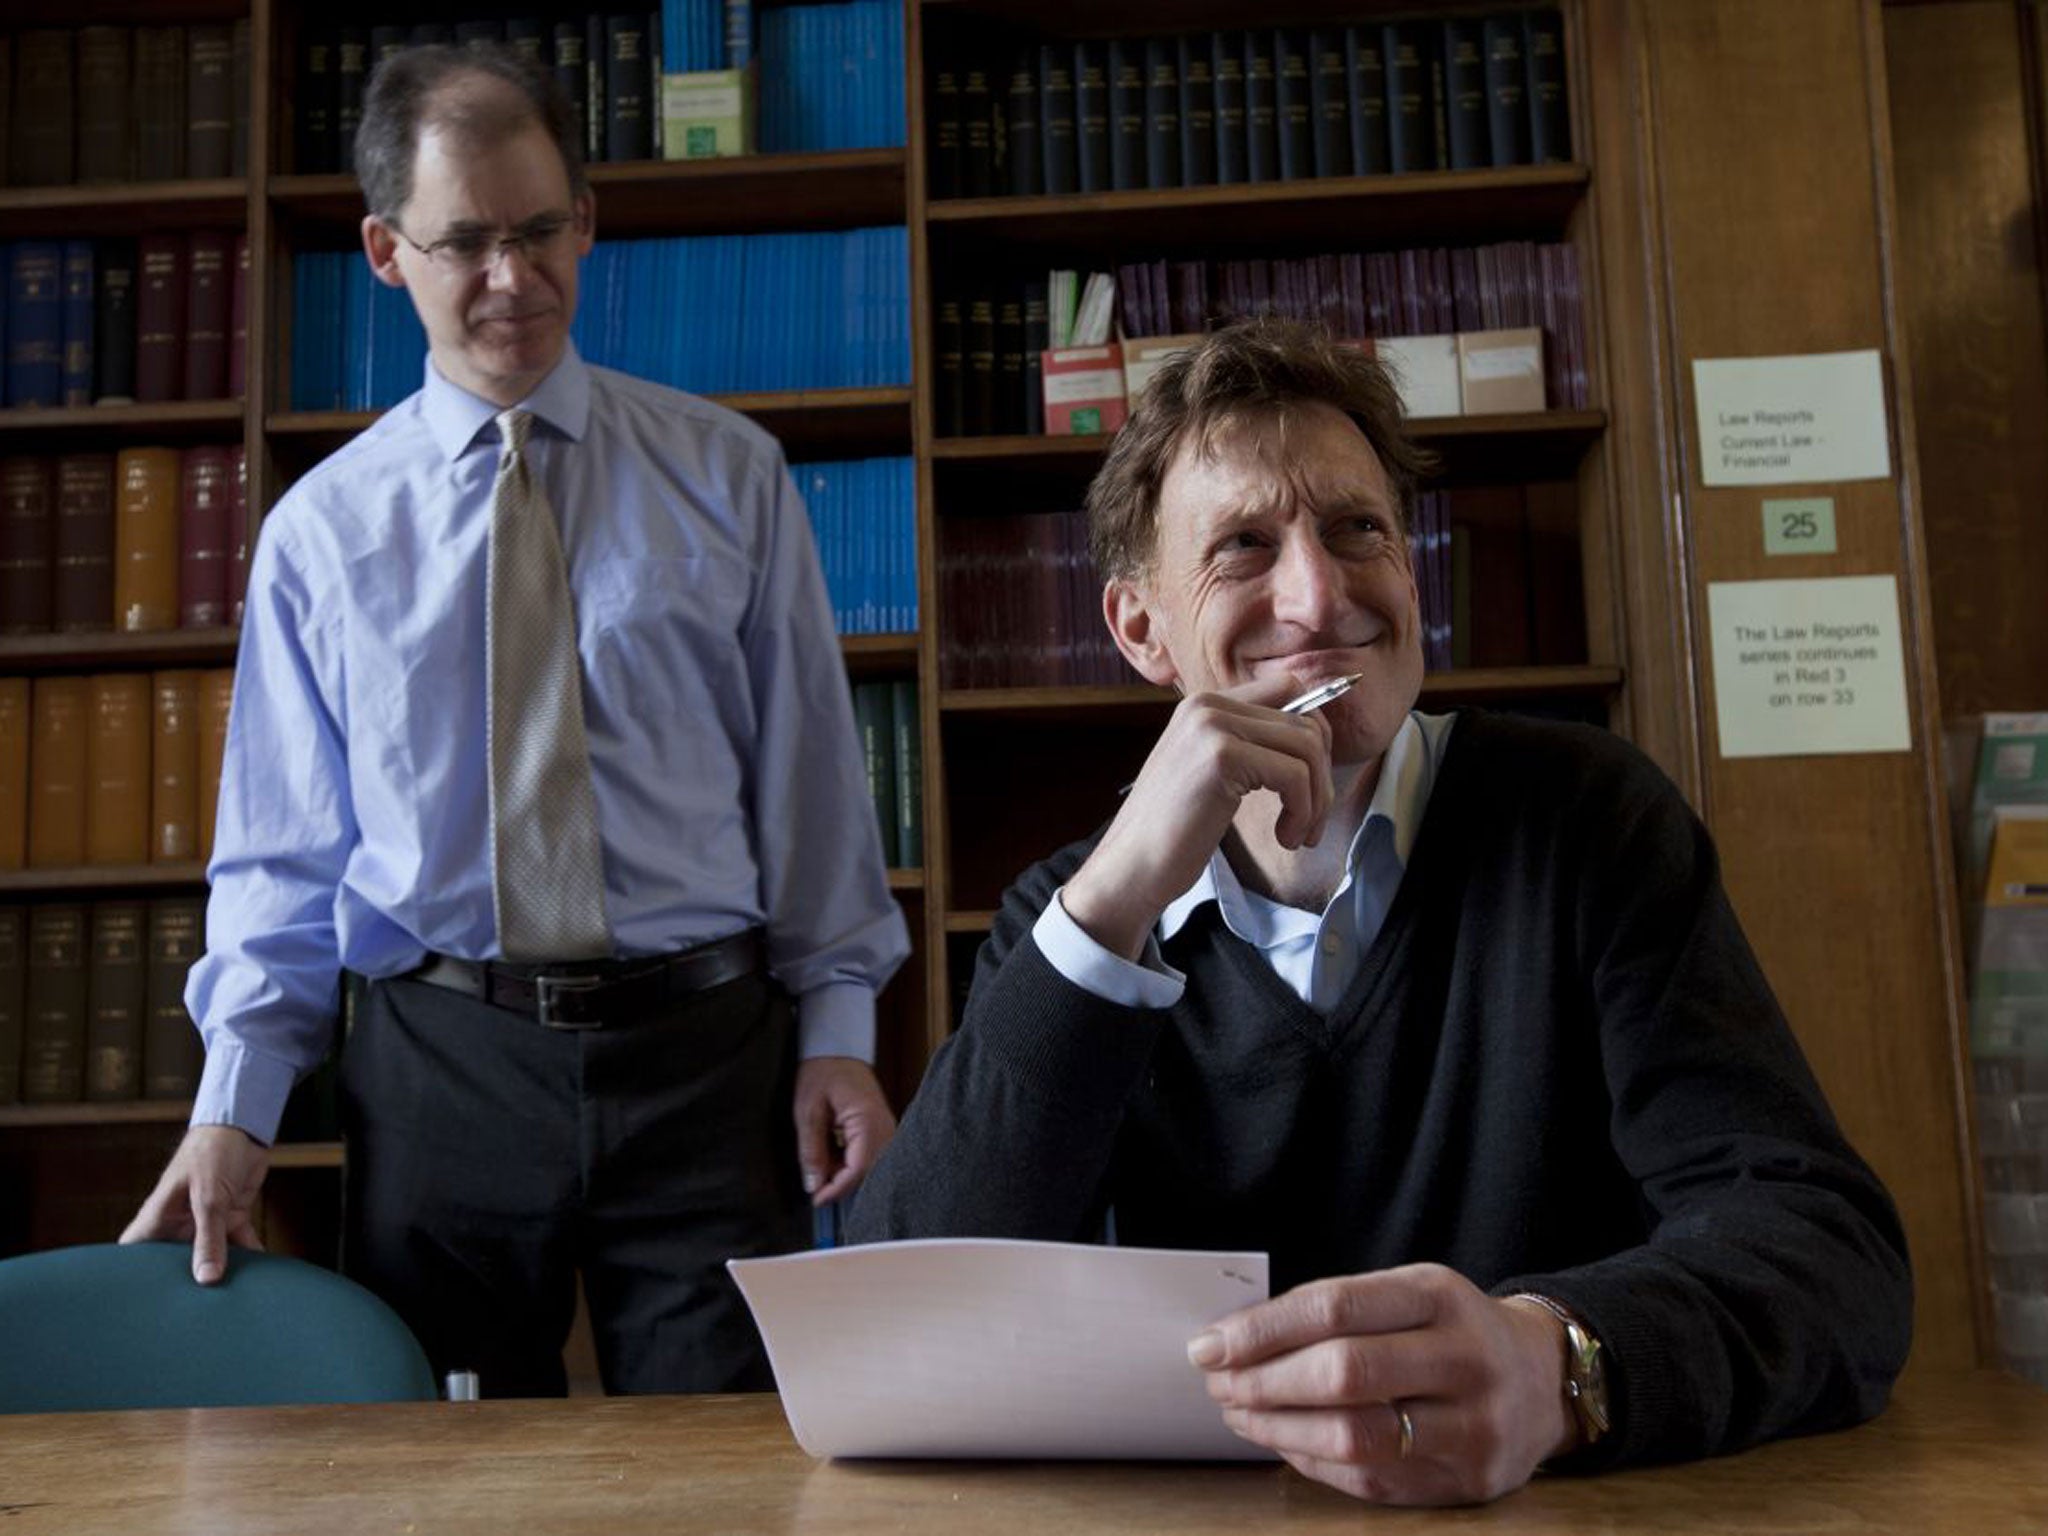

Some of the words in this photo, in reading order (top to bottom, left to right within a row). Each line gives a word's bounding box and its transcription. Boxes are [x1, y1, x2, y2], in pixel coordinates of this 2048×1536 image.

[1719, 412, 1749, 426] Law
[1755, 410, 1815, 427] Reports
[1721, 434, 1777, 450] Current
[1783, 432, 1812, 446] Law
[1782, 512, 1818, 539] 25
[1734, 626, 1766, 641] The
[1773, 626, 1806, 640] Law
[1813, 623, 1880, 641] Reports
